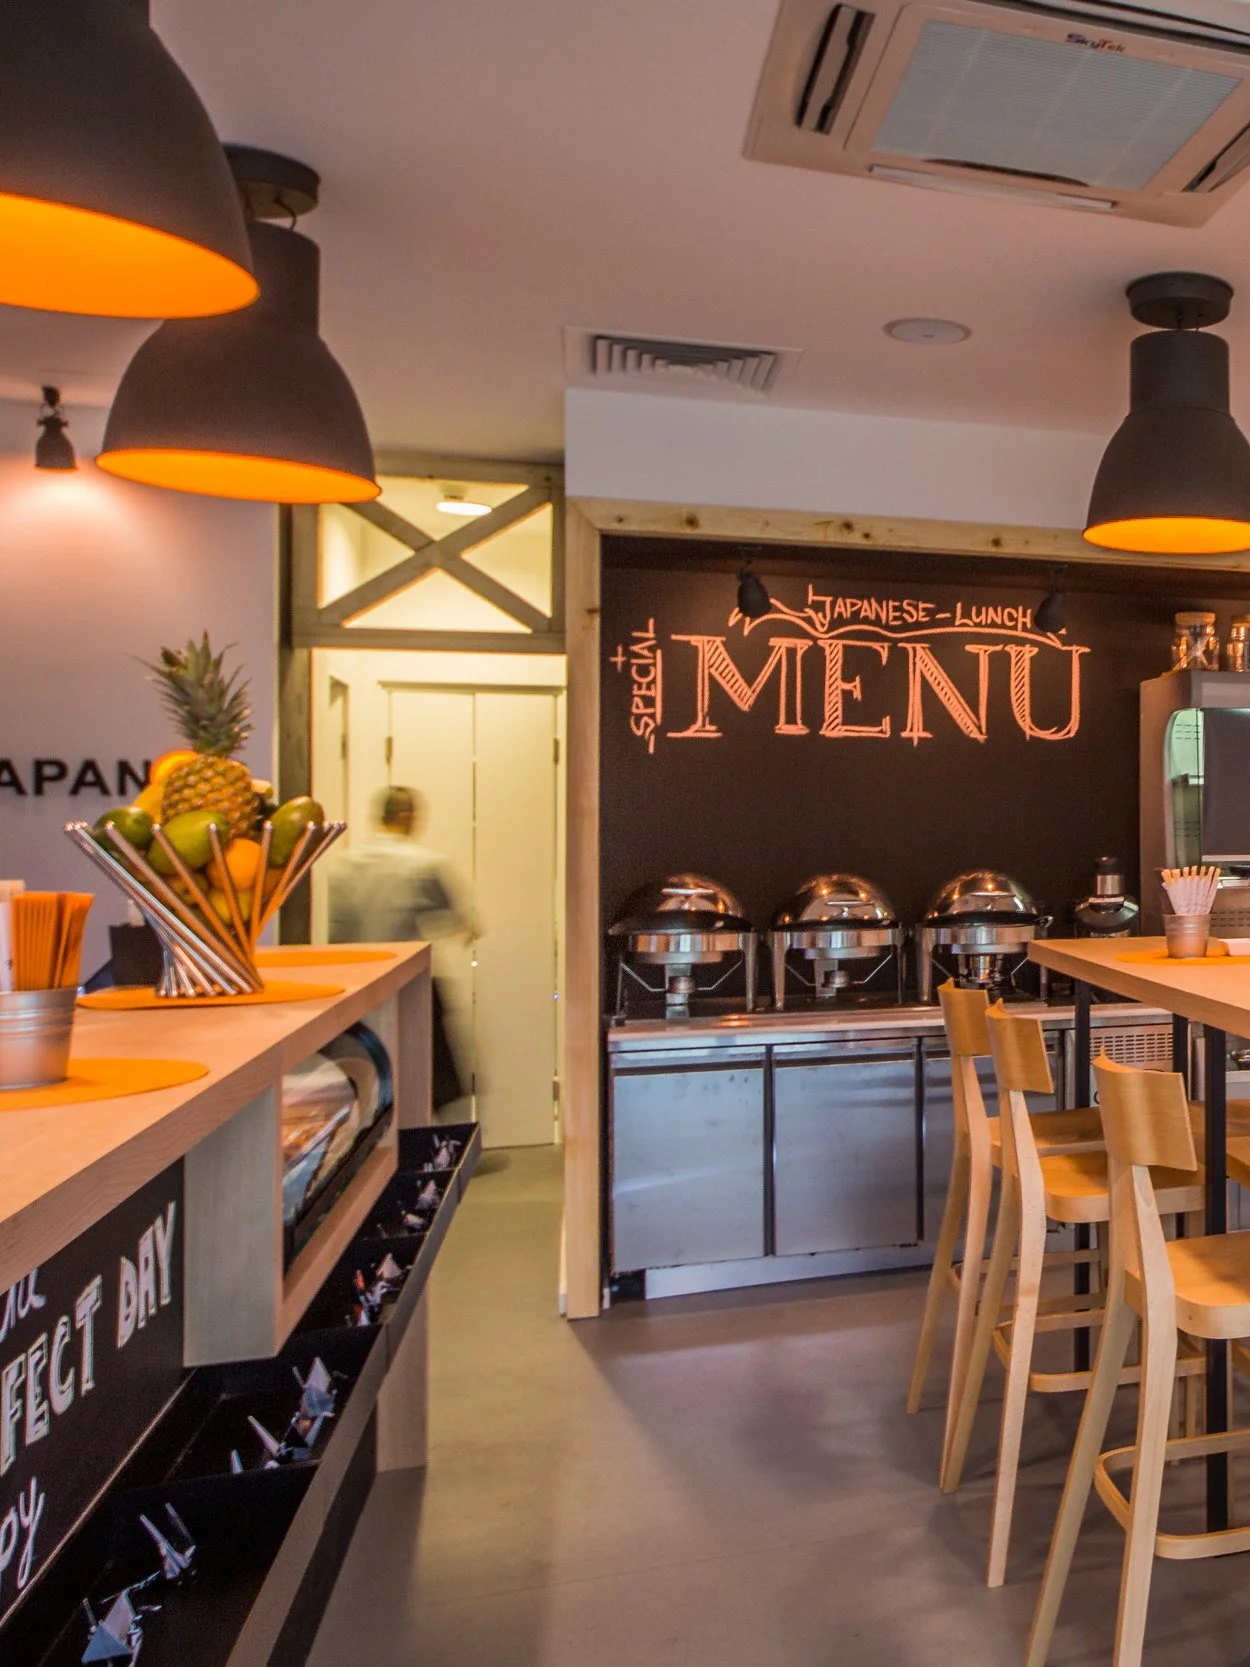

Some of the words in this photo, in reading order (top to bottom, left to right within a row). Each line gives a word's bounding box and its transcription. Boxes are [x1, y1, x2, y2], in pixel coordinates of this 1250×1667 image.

[629, 616, 657, 741] SPECIAL
[667, 634, 1091, 746] MENU
[117, 1201, 176, 1348] DAY
